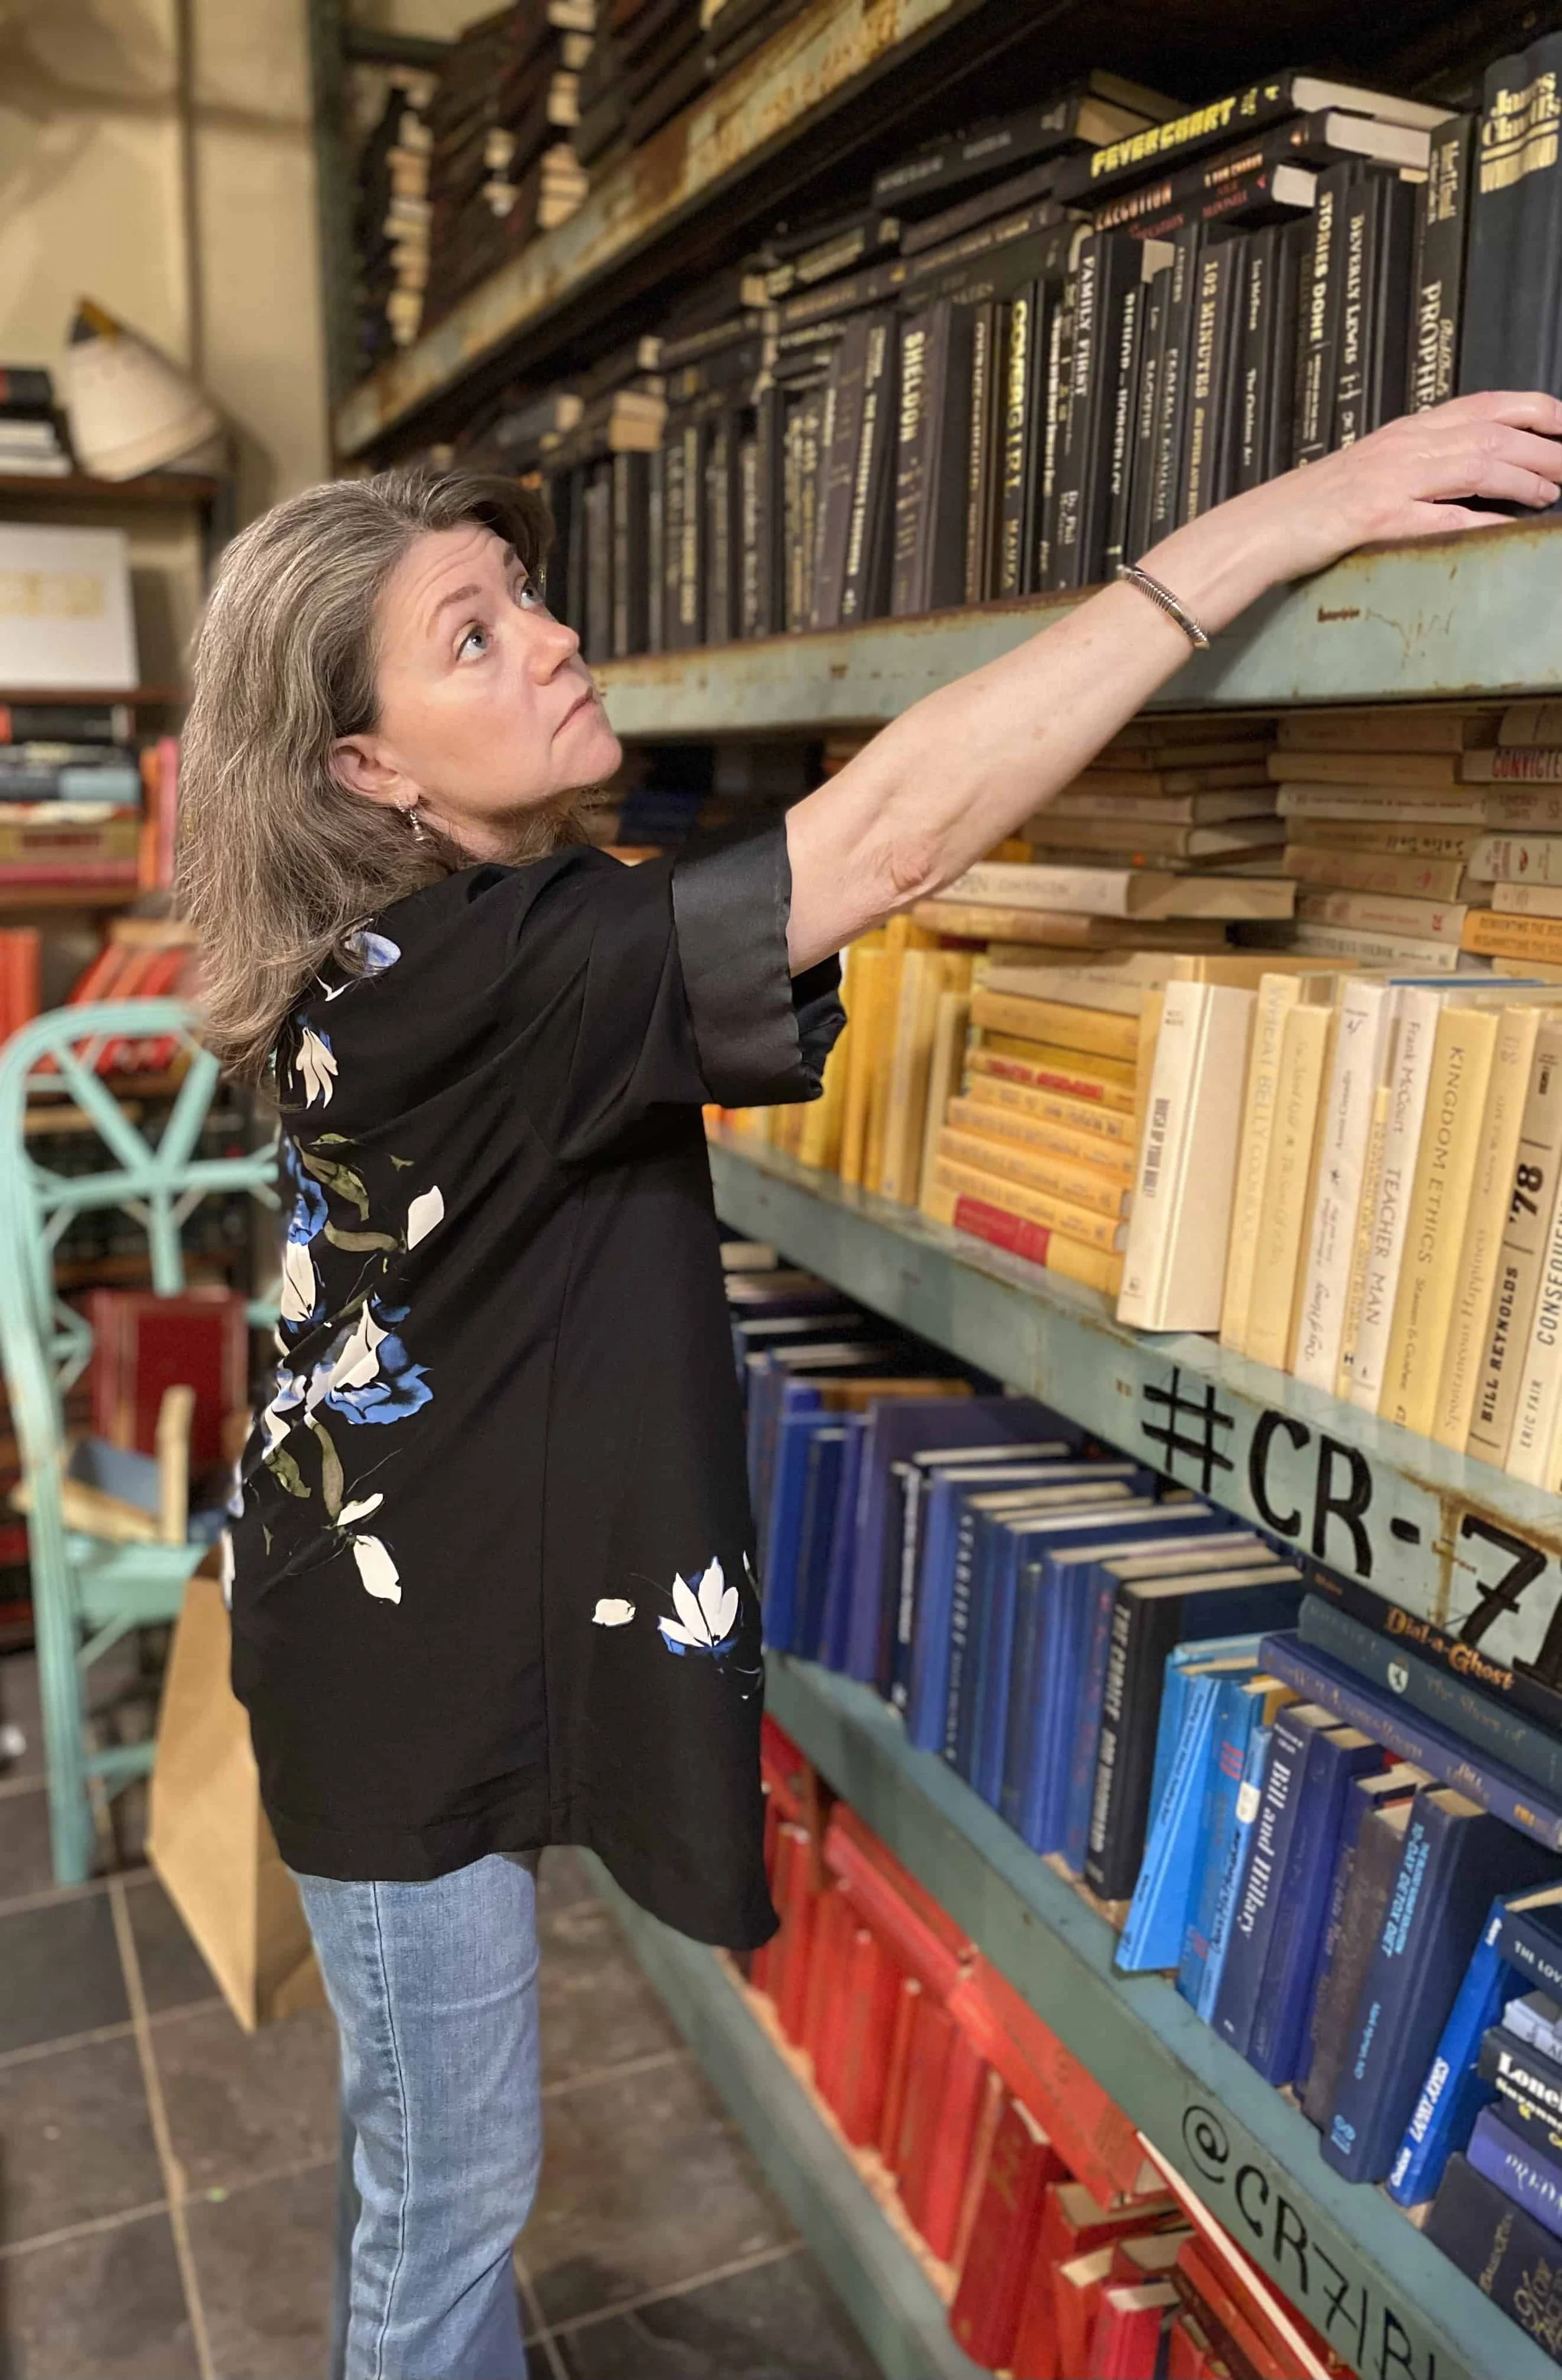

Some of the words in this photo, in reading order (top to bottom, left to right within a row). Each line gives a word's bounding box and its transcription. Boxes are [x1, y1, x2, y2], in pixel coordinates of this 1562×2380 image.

[1315, 191, 1333, 279] STORIES
[1346, 213, 1365, 300] BEVERLY
[1202, 259, 1220, 297] 102
[1309, 280, 1327, 342] DONE
[1344, 303, 1361, 364] LEWIS
[1194, 300, 1216, 400] MINUTES
[900, 329, 926, 444] SHELDON
[1407, 1019, 1421, 1060] Frank
[1395, 1065, 1416, 1134] McCourt
[1433, 1044, 1465, 1169] KINGDOM
[1374, 1167, 1401, 1258] TEACHER
[1417, 1176, 1447, 1266] ETHICS
[1508, 1163, 1544, 1227] '78
[1363, 1270, 1386, 1326] MAN
[1460, 1226, 1488, 1316] Happiness
[1487, 1265, 1520, 1373] REYNOLDS
[1481, 1377, 1500, 1425] BILL
[1526, 1379, 1544, 1409] FAIR
[1519, 1409, 1537, 1449] ERIC
[1383, 1605, 1515, 1690] Dial-a-Ghost
[1268, 1758, 1293, 1810] Bill
[1258, 1809, 1278, 1859] and
[1238, 1854, 1271, 1938] Hillary
[1392, 1870, 1415, 1922] DETOX
[1381, 1918, 1401, 1958] DIET
[1514, 1940, 1536, 1964] THE
[1538, 1959, 1562, 1986] LOV
